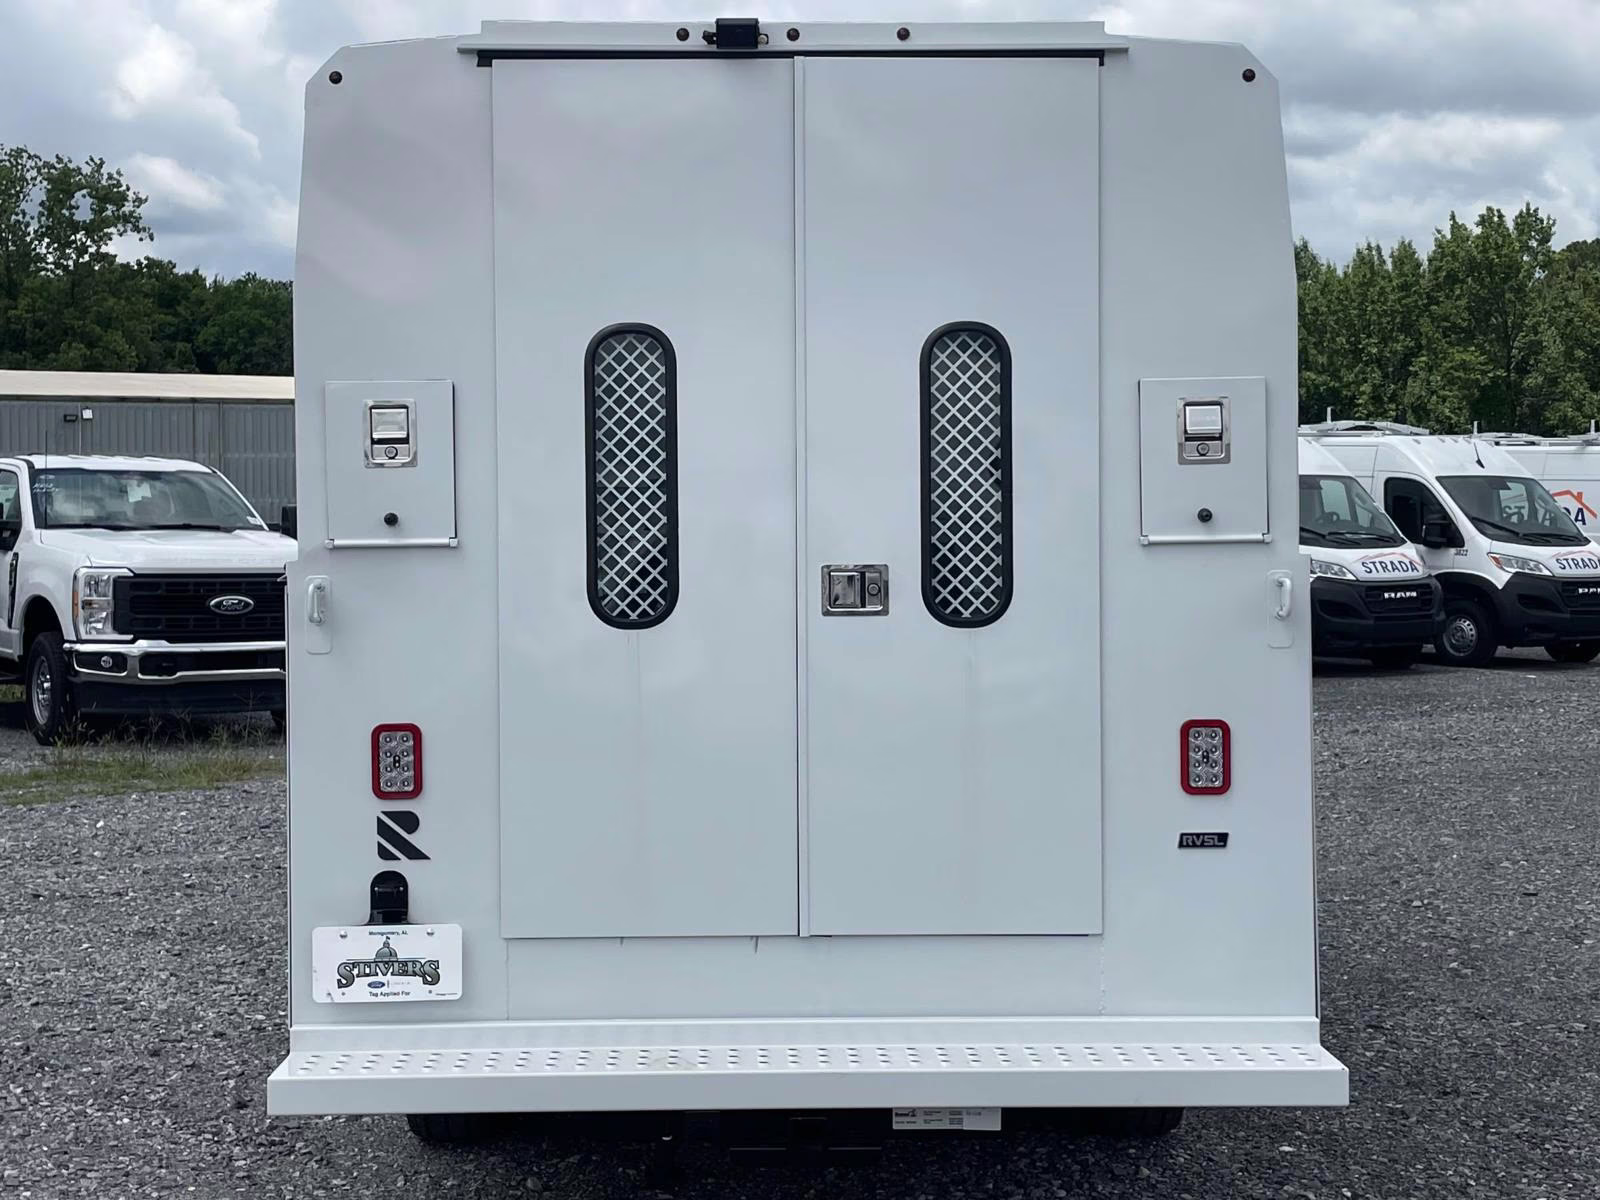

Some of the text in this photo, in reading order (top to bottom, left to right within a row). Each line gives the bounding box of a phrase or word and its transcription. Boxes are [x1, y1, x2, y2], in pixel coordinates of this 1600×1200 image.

[1361, 560, 1420, 574] STRADA
[1556, 557, 1600, 570] STRAD
[1384, 591, 1417, 599] RAM
[1182, 834, 1225, 846] RVSL
[337, 960, 440, 988] STIVERS
